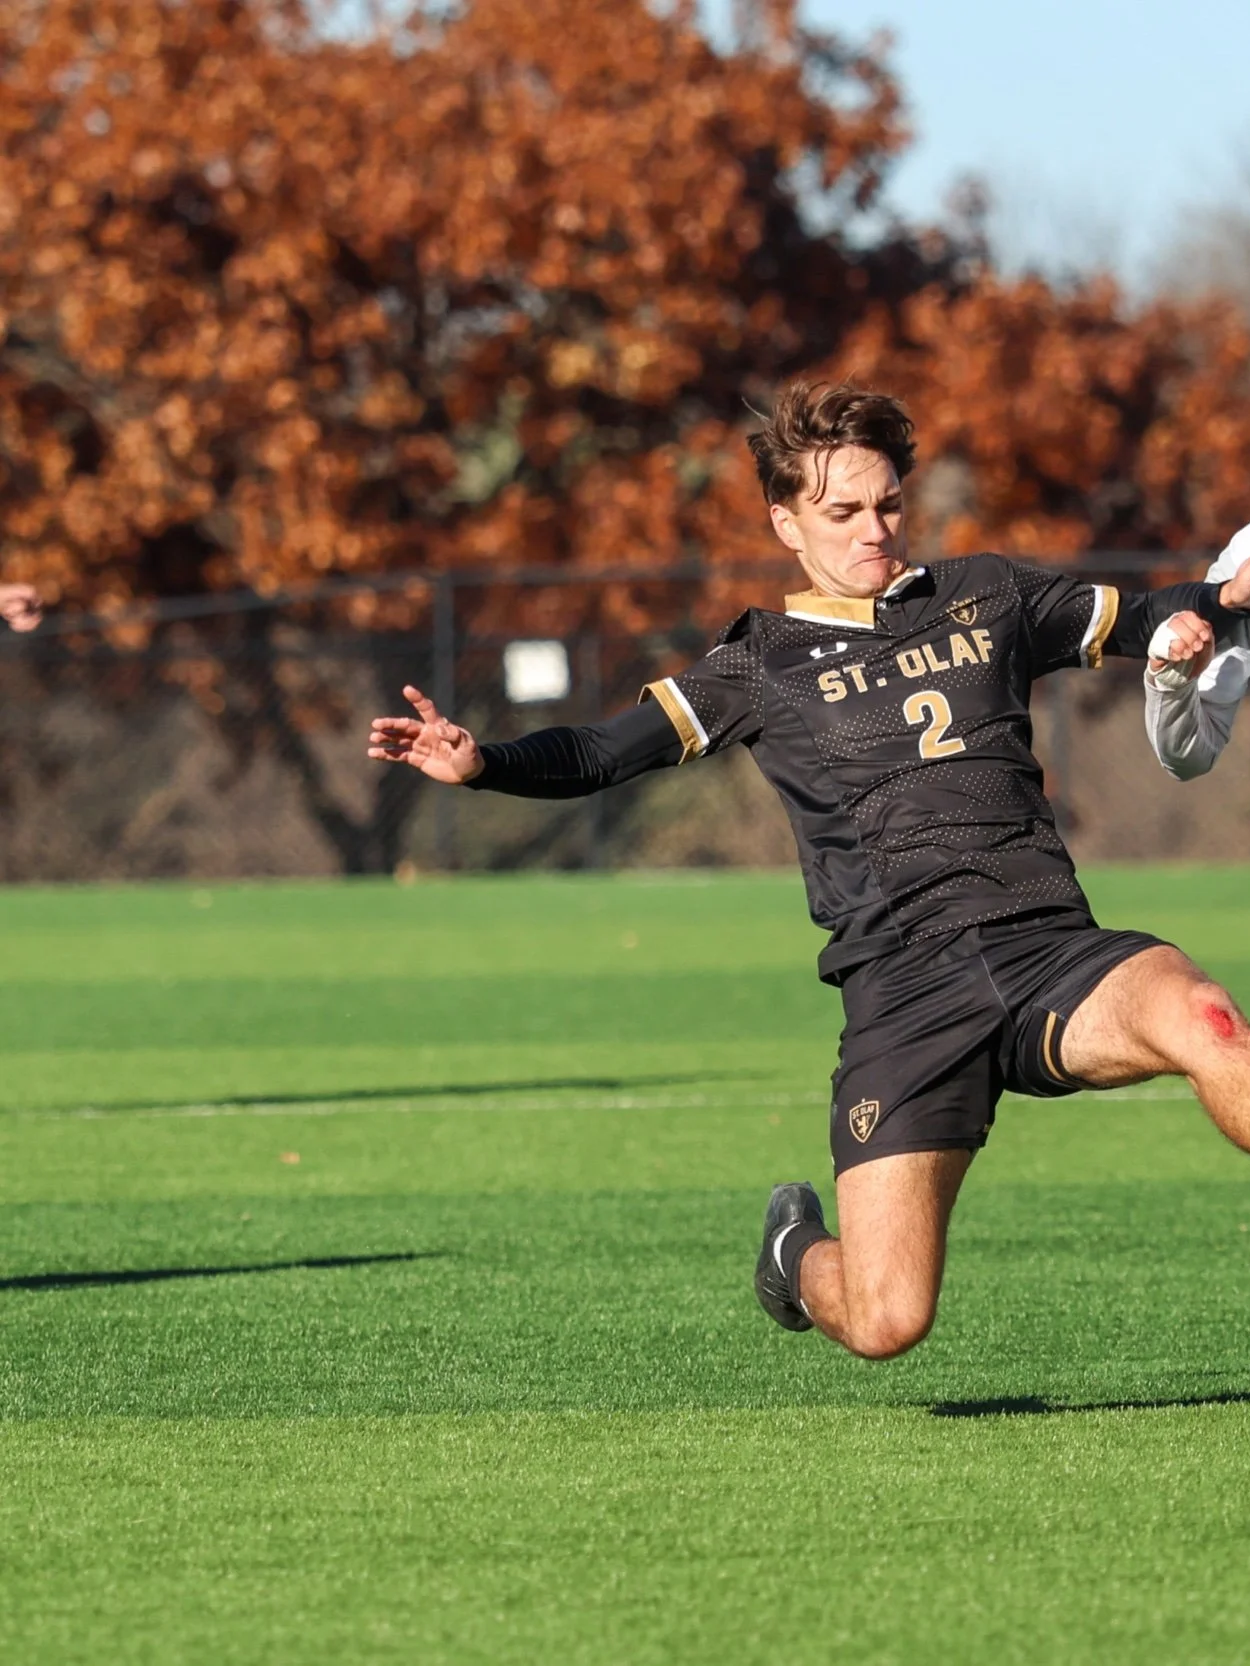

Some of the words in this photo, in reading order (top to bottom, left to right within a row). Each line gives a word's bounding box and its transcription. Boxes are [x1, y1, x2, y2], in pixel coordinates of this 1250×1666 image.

[818, 663, 887, 703] ST.
[896, 628, 994, 678] OLAF
[902, 690, 966, 759] 2
